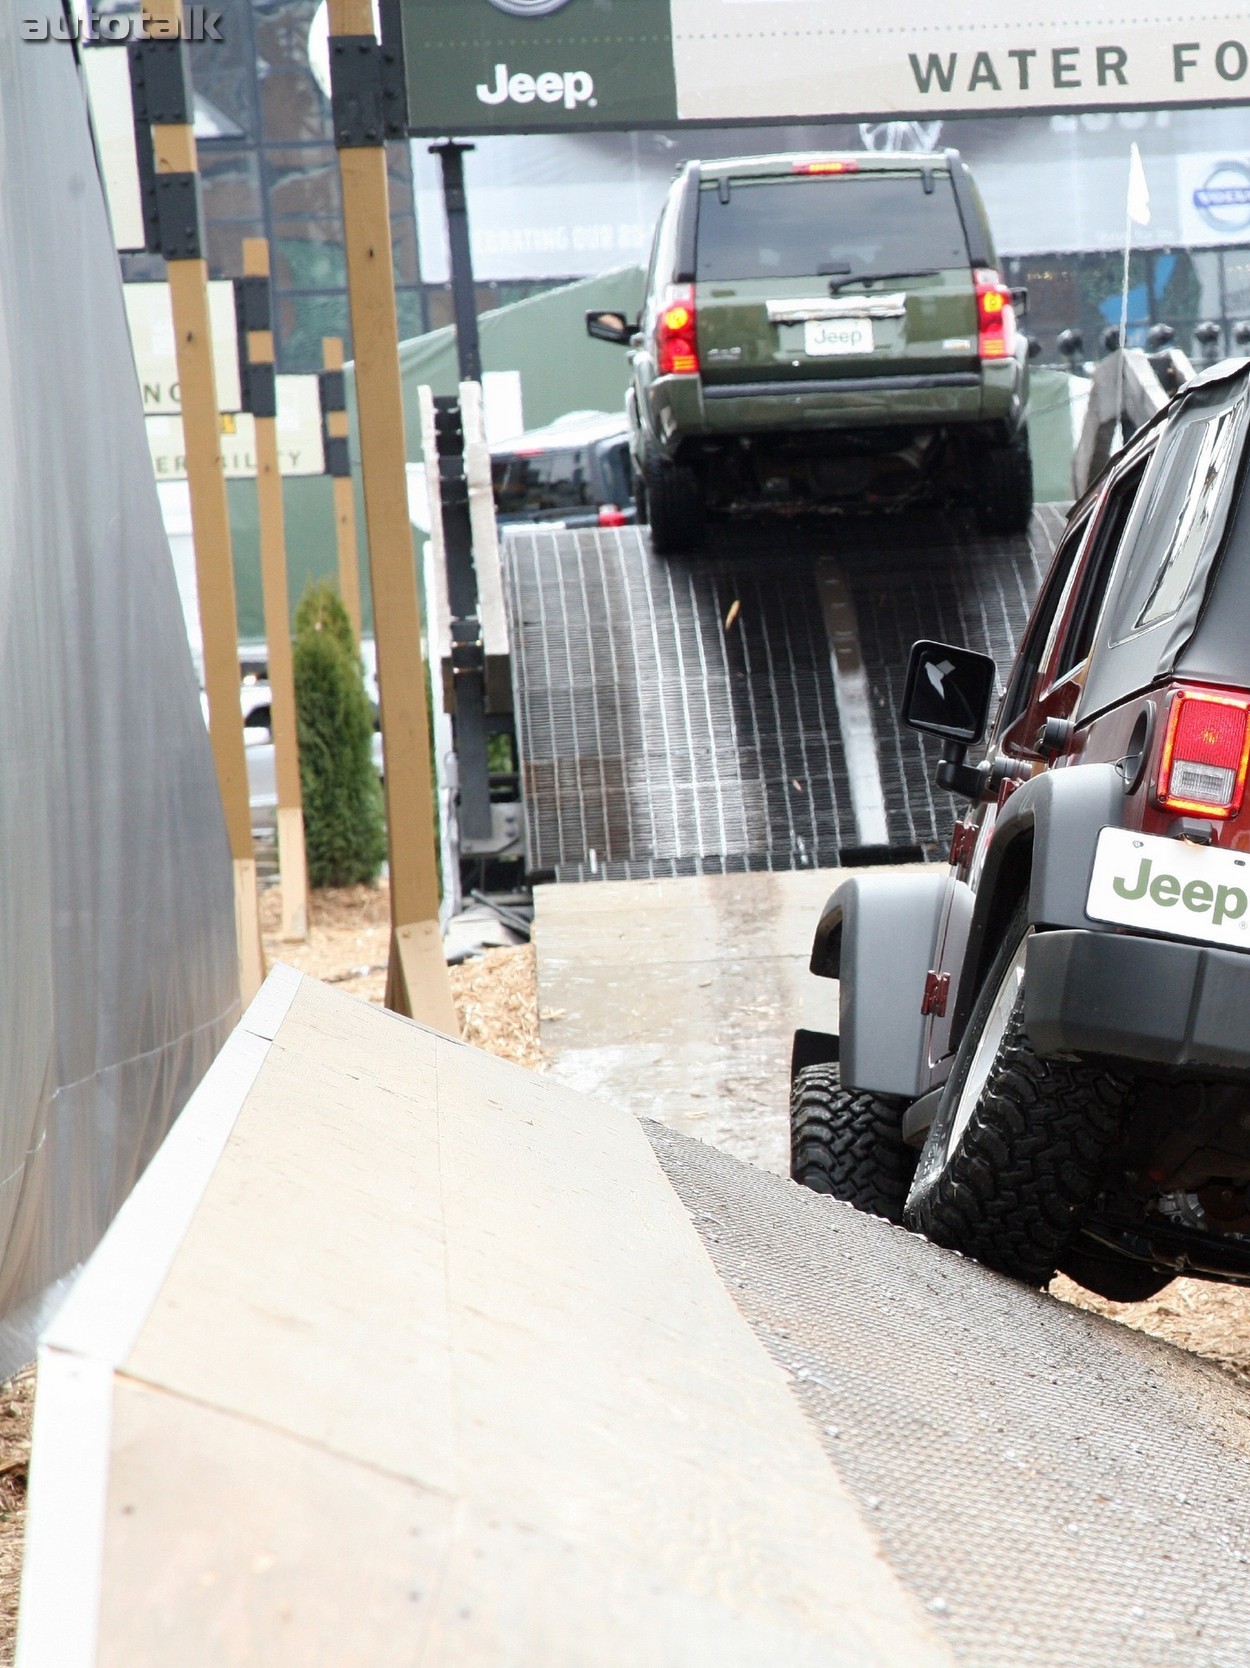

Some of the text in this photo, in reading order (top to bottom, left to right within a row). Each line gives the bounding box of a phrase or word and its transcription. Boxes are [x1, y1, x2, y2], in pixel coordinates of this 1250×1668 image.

[475, 63, 594, 110] Jeep
[907, 46, 1130, 94] WATER
[813, 328, 863, 346] Jeep
[1112, 857, 1249, 926] Jeep
